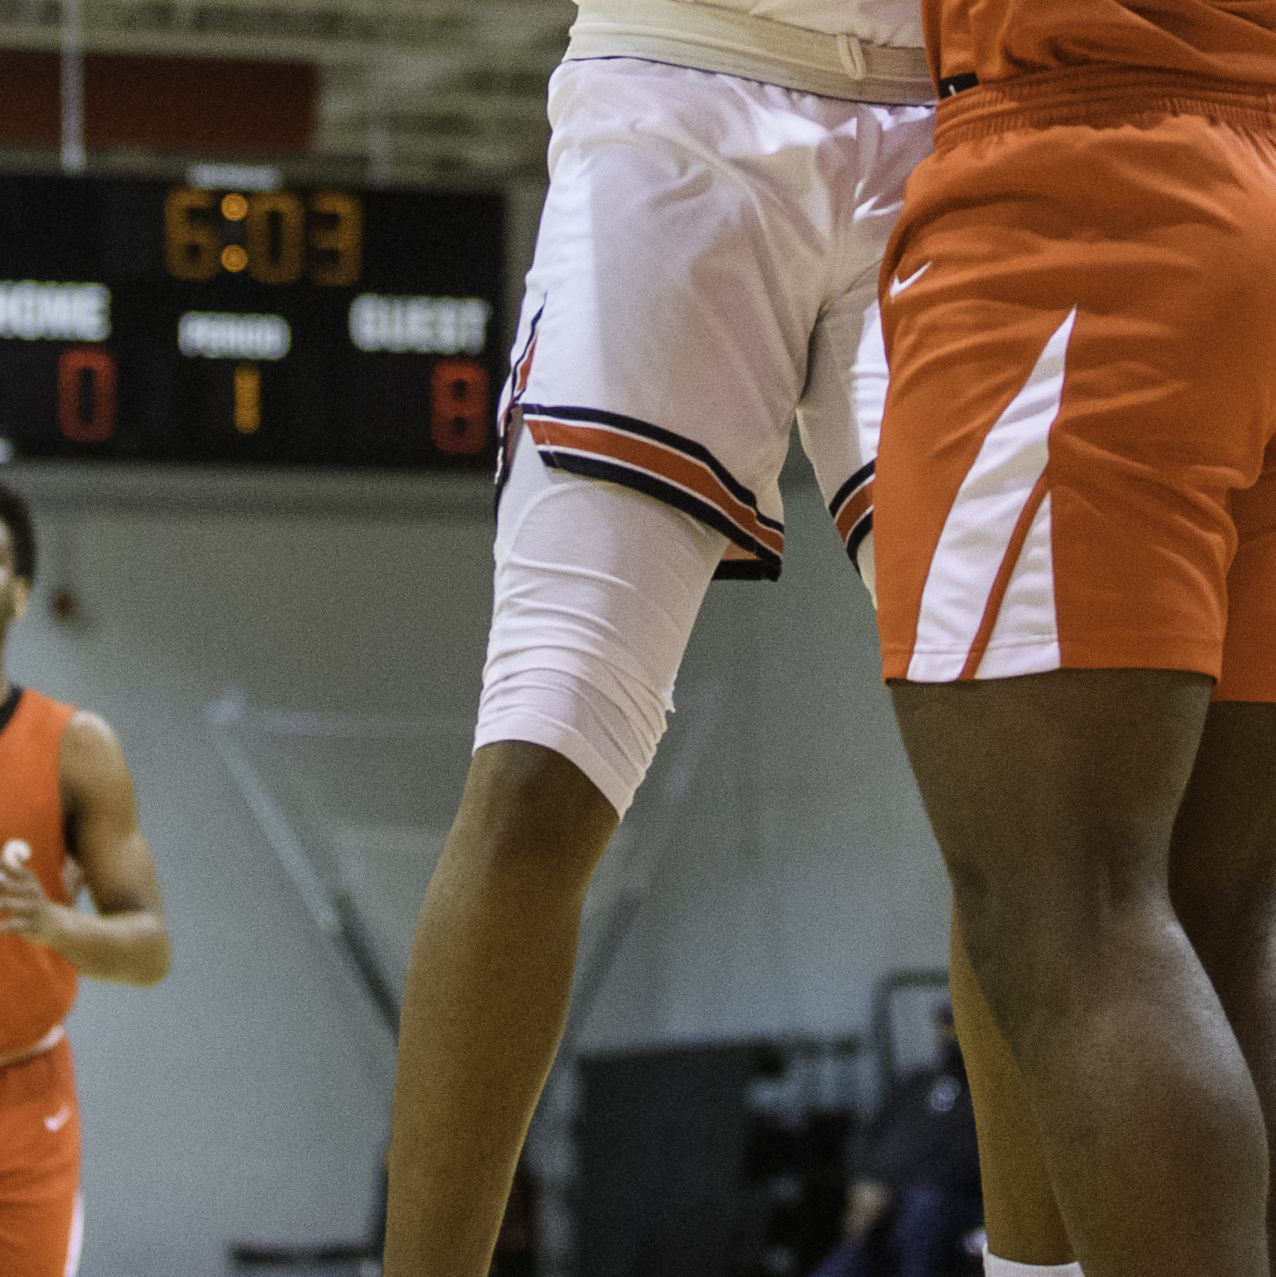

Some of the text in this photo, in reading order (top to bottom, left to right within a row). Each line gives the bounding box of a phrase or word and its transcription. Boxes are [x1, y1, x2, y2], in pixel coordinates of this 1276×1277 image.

[164, 188, 364, 286] 6:03
[57, 346, 119, 442] 0
[233, 361, 262, 436] 1
[429, 359, 492, 455] 8
